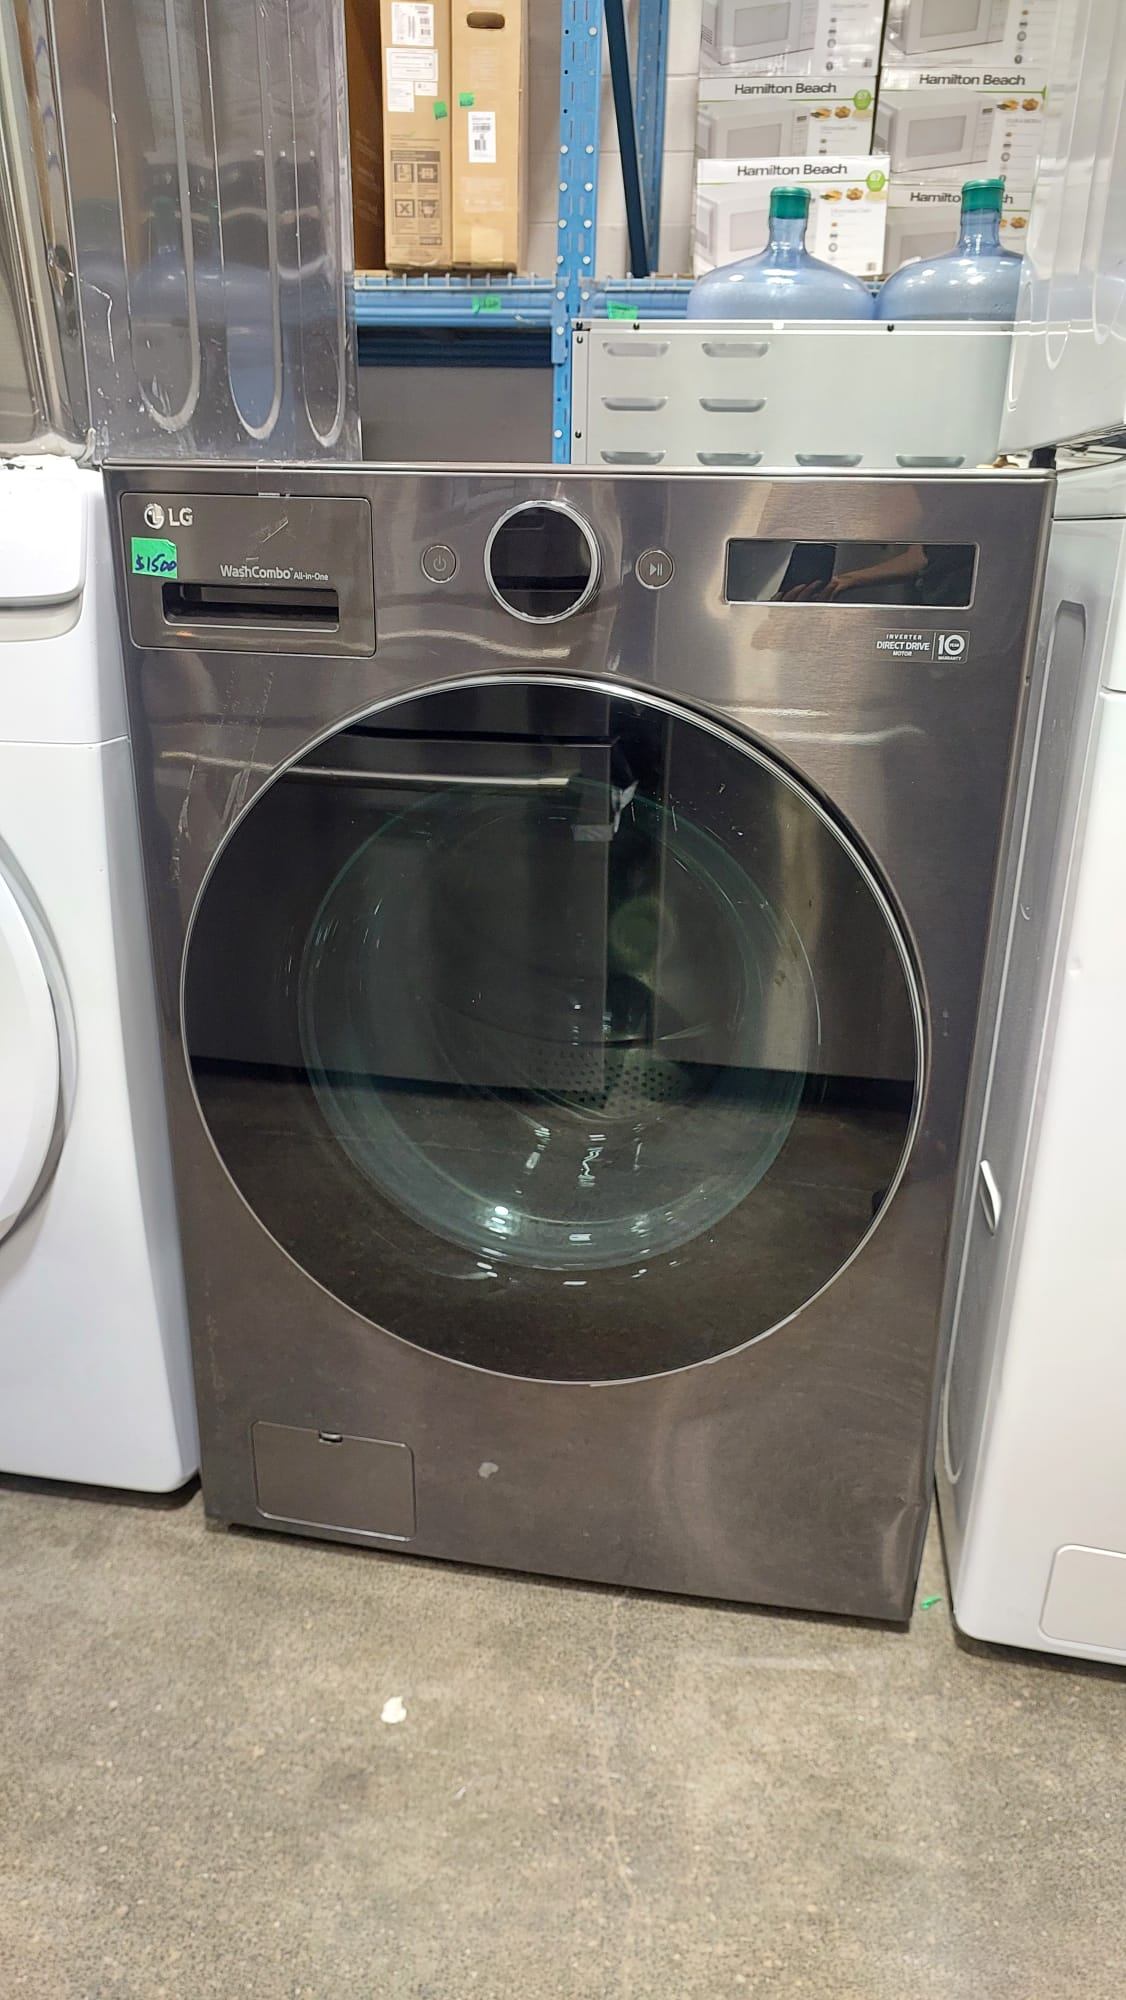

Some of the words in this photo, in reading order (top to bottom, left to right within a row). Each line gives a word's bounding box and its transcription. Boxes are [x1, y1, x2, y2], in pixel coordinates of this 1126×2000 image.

[919, 74, 980, 85] Hamilton
[983, 74, 1026, 86] Beach
[734, 83, 793, 95] Hamilton
[795, 82, 837, 94] Beach
[737, 165, 800, 177] Hamilton
[803, 163, 848, 175] Beach
[910, 191, 962, 203] Hamilto
[169, 507, 194, 527] LG
[135, 553, 177, 573] $1500
[293, 571, 329, 581] All-in-One
[876, 640, 904, 650] DIRECT
[905, 641, 931, 651] DRIVE
[938, 634, 965, 656] 10
